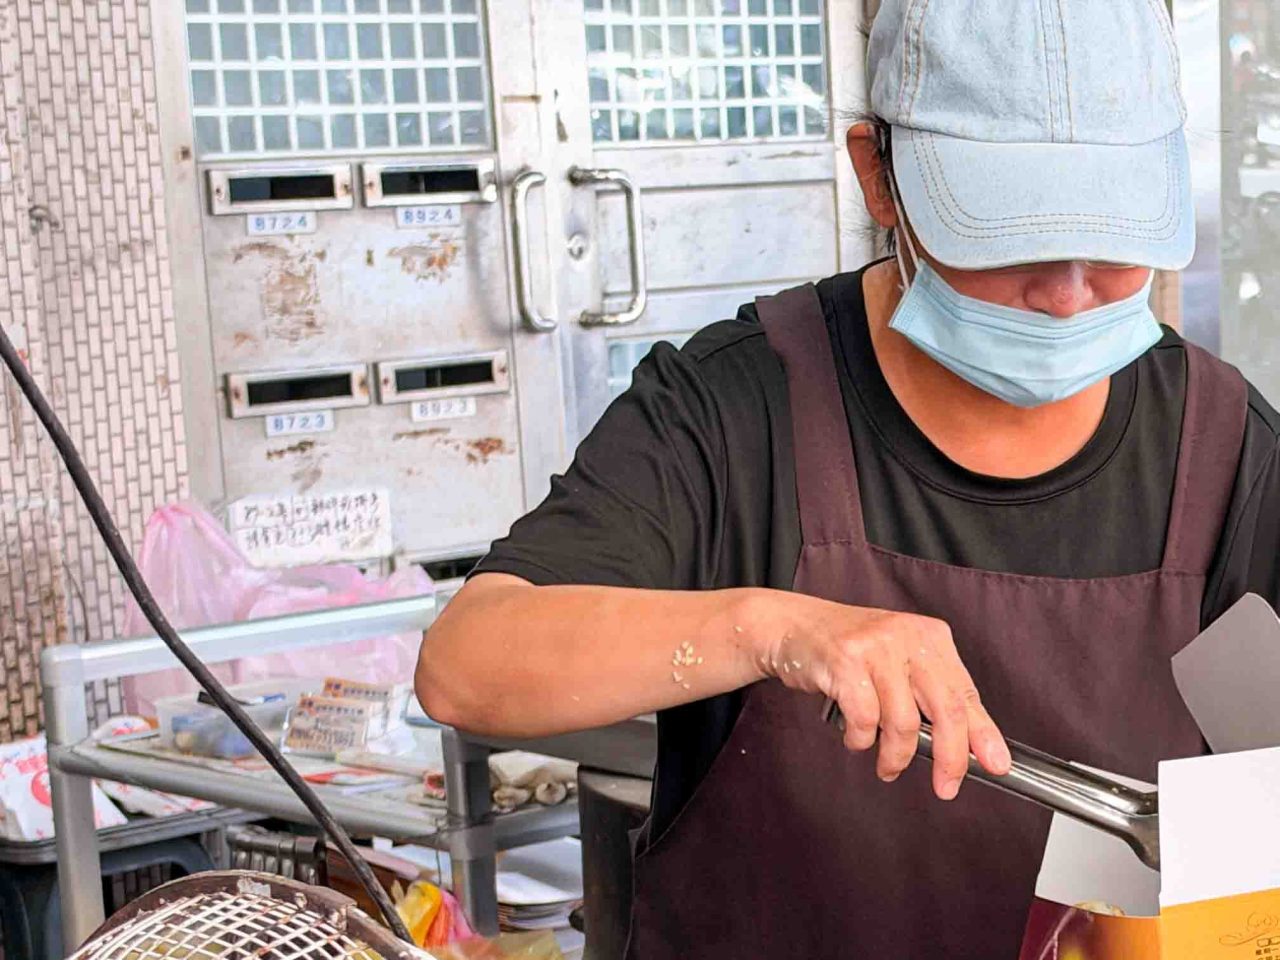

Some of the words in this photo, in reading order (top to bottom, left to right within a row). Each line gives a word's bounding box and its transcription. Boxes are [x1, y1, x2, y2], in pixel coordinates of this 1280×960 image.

[254, 214, 308, 230] 8724
[402, 207, 453, 223] 8924
[273, 414, 326, 432] 8723
